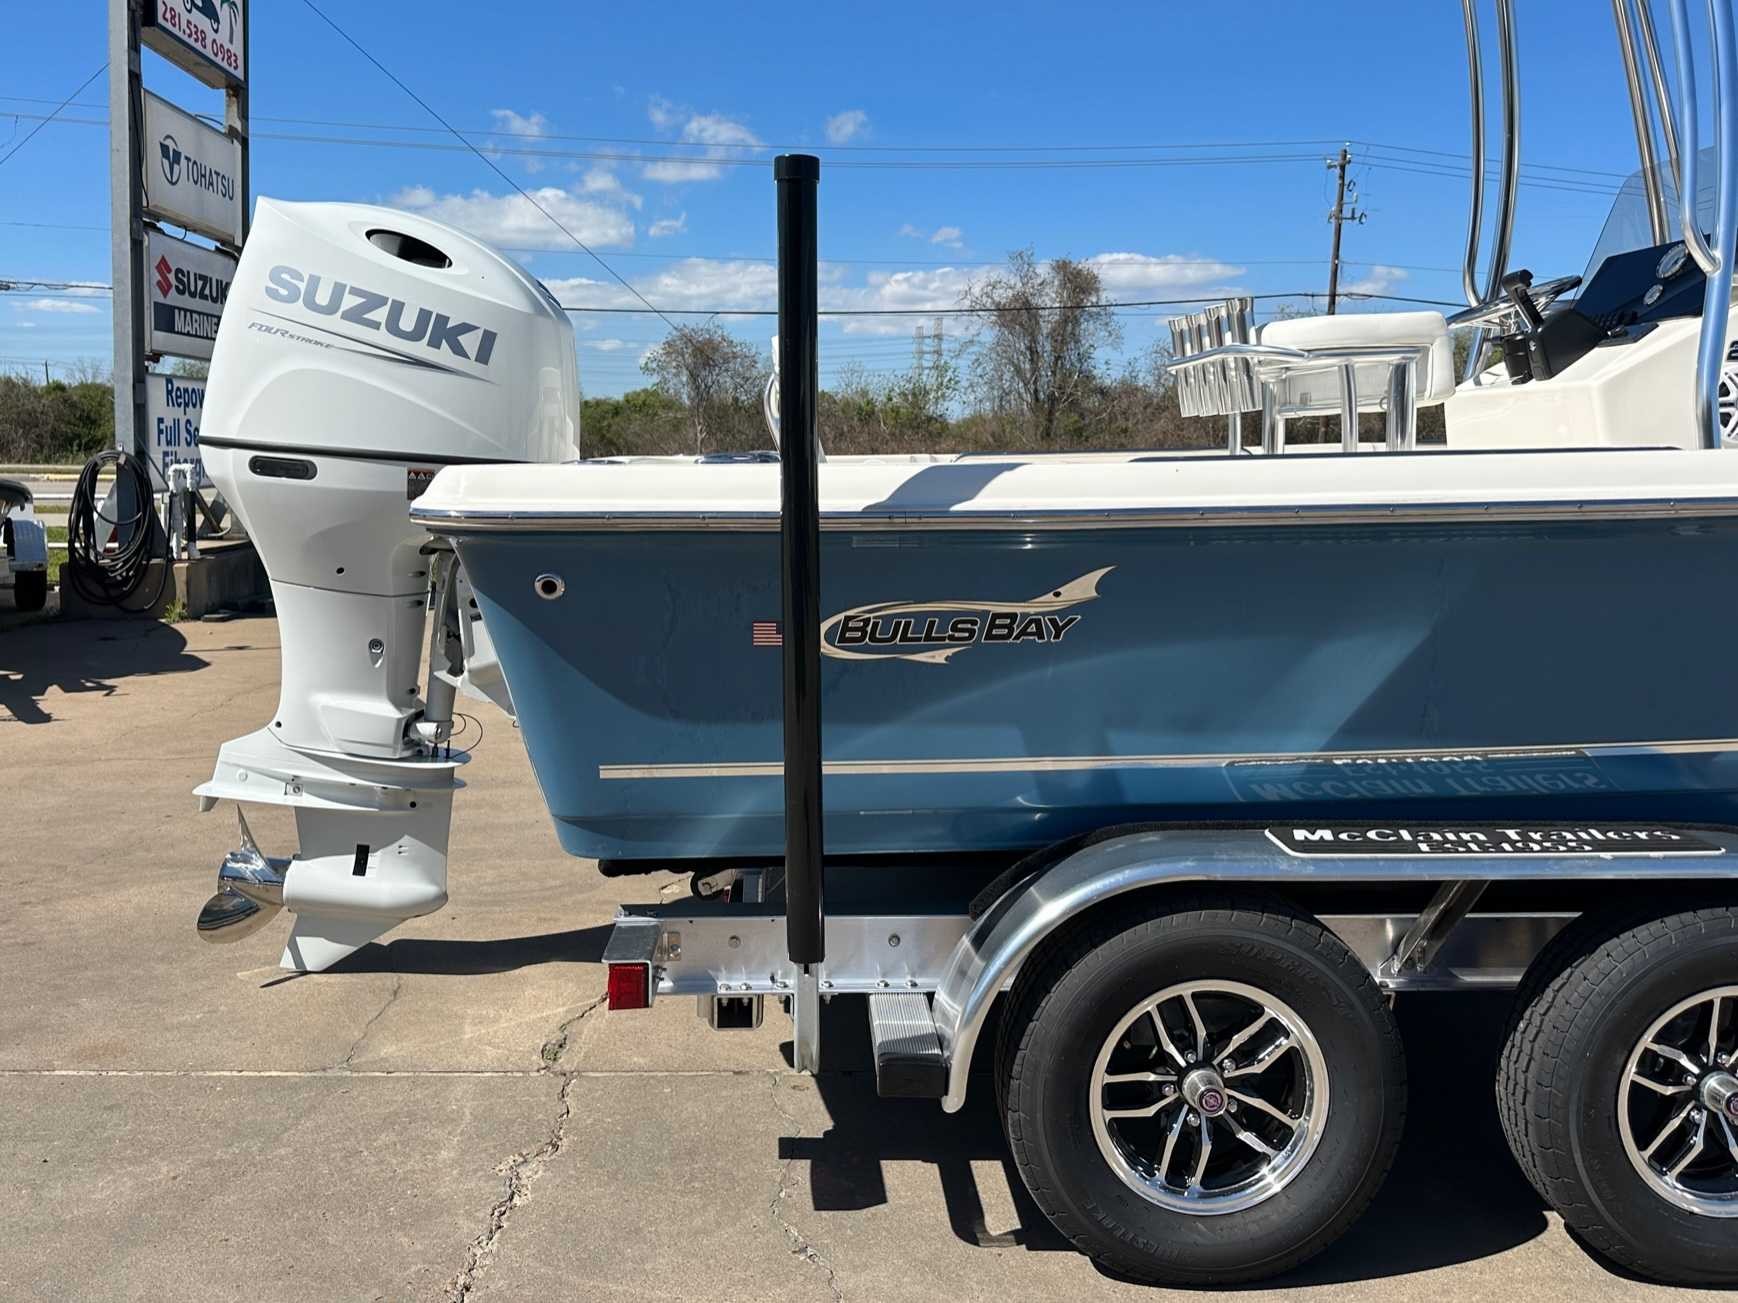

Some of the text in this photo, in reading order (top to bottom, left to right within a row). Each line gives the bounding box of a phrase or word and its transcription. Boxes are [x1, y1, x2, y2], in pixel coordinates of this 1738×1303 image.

[162, 1, 239, 70] 281.538 0983
[184, 156, 234, 200] TOHATSU
[174, 308, 218, 338] MARINE
[265, 265, 497, 366] SUZUKI
[157, 417, 180, 447] Full
[835, 611, 1081, 646] BULLS BAY
[1293, 828, 1680, 841] McClain Trailers
